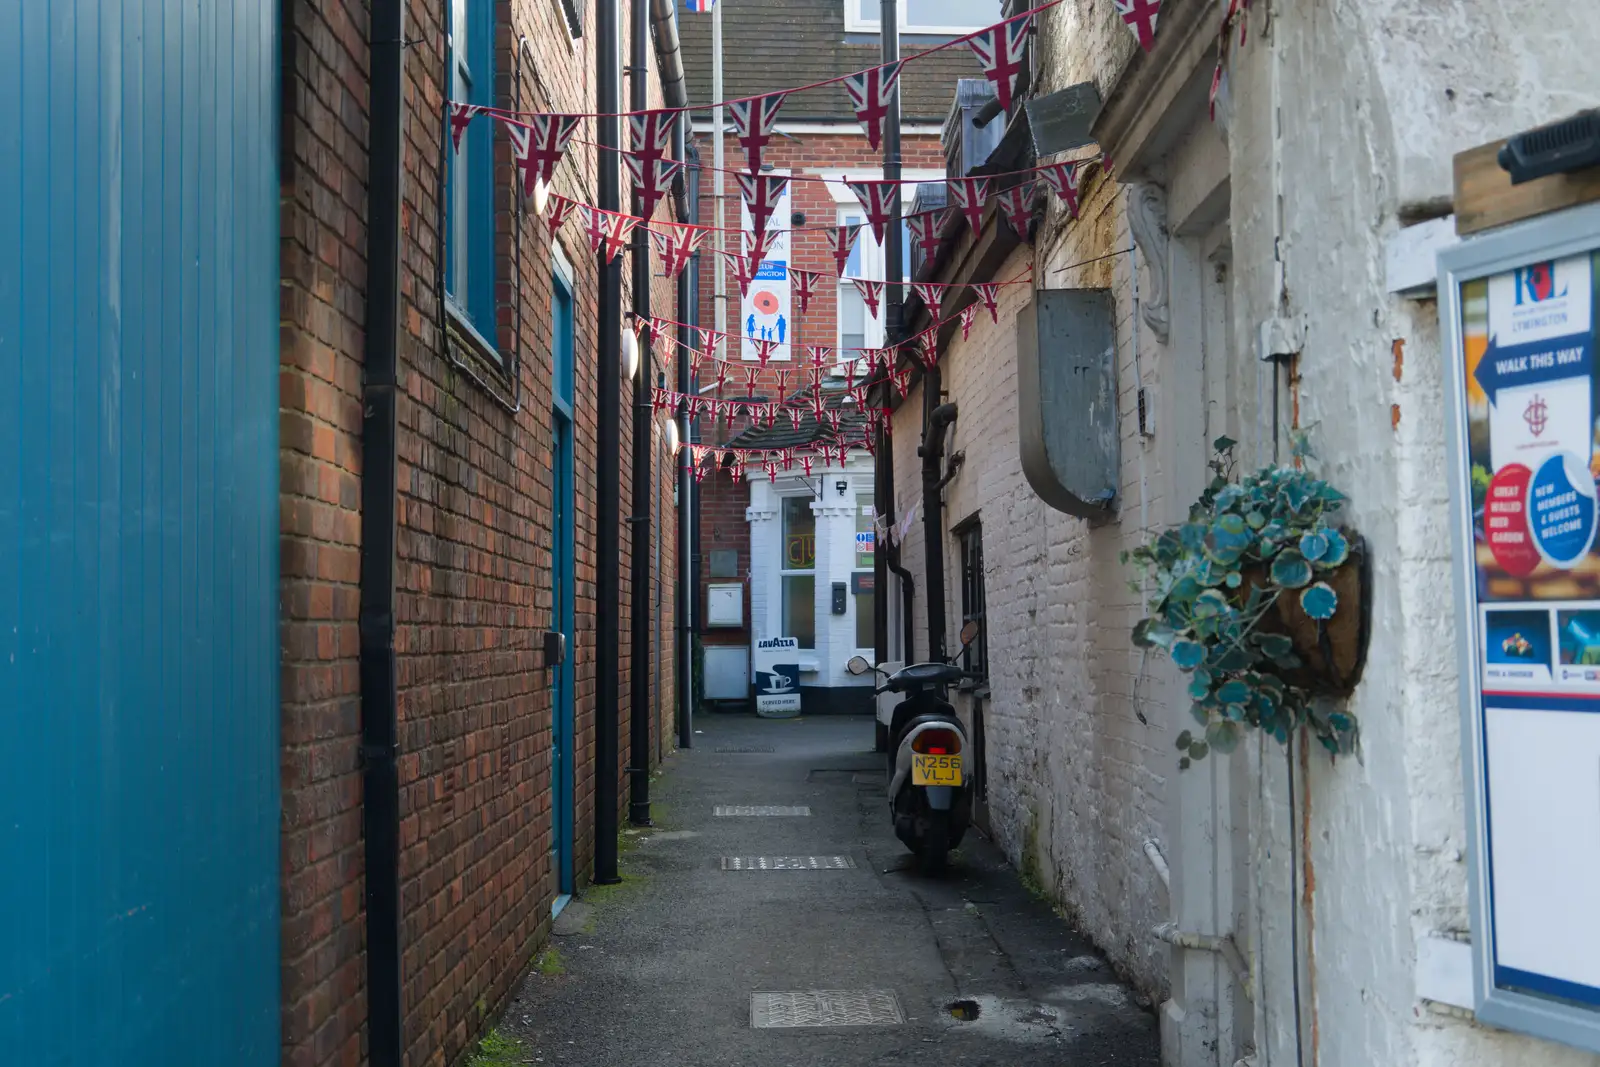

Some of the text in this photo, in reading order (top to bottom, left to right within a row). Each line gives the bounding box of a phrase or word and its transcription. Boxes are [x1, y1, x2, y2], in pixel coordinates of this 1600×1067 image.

[1496, 346, 1584, 375] WALK THIS WAY
[1493, 486, 1519, 497] GREAT
[1536, 483, 1554, 497] NEW
[1537, 491, 1576, 511] MEMBERS
[1548, 505, 1579, 522] GUESTS
[1541, 519, 1582, 539] WELCOME
[1491, 532, 1523, 543] GARDEN
[758, 637, 795, 648] LAVAZZA
[916, 756, 961, 769] N256
[922, 769, 954, 781] VLJ
